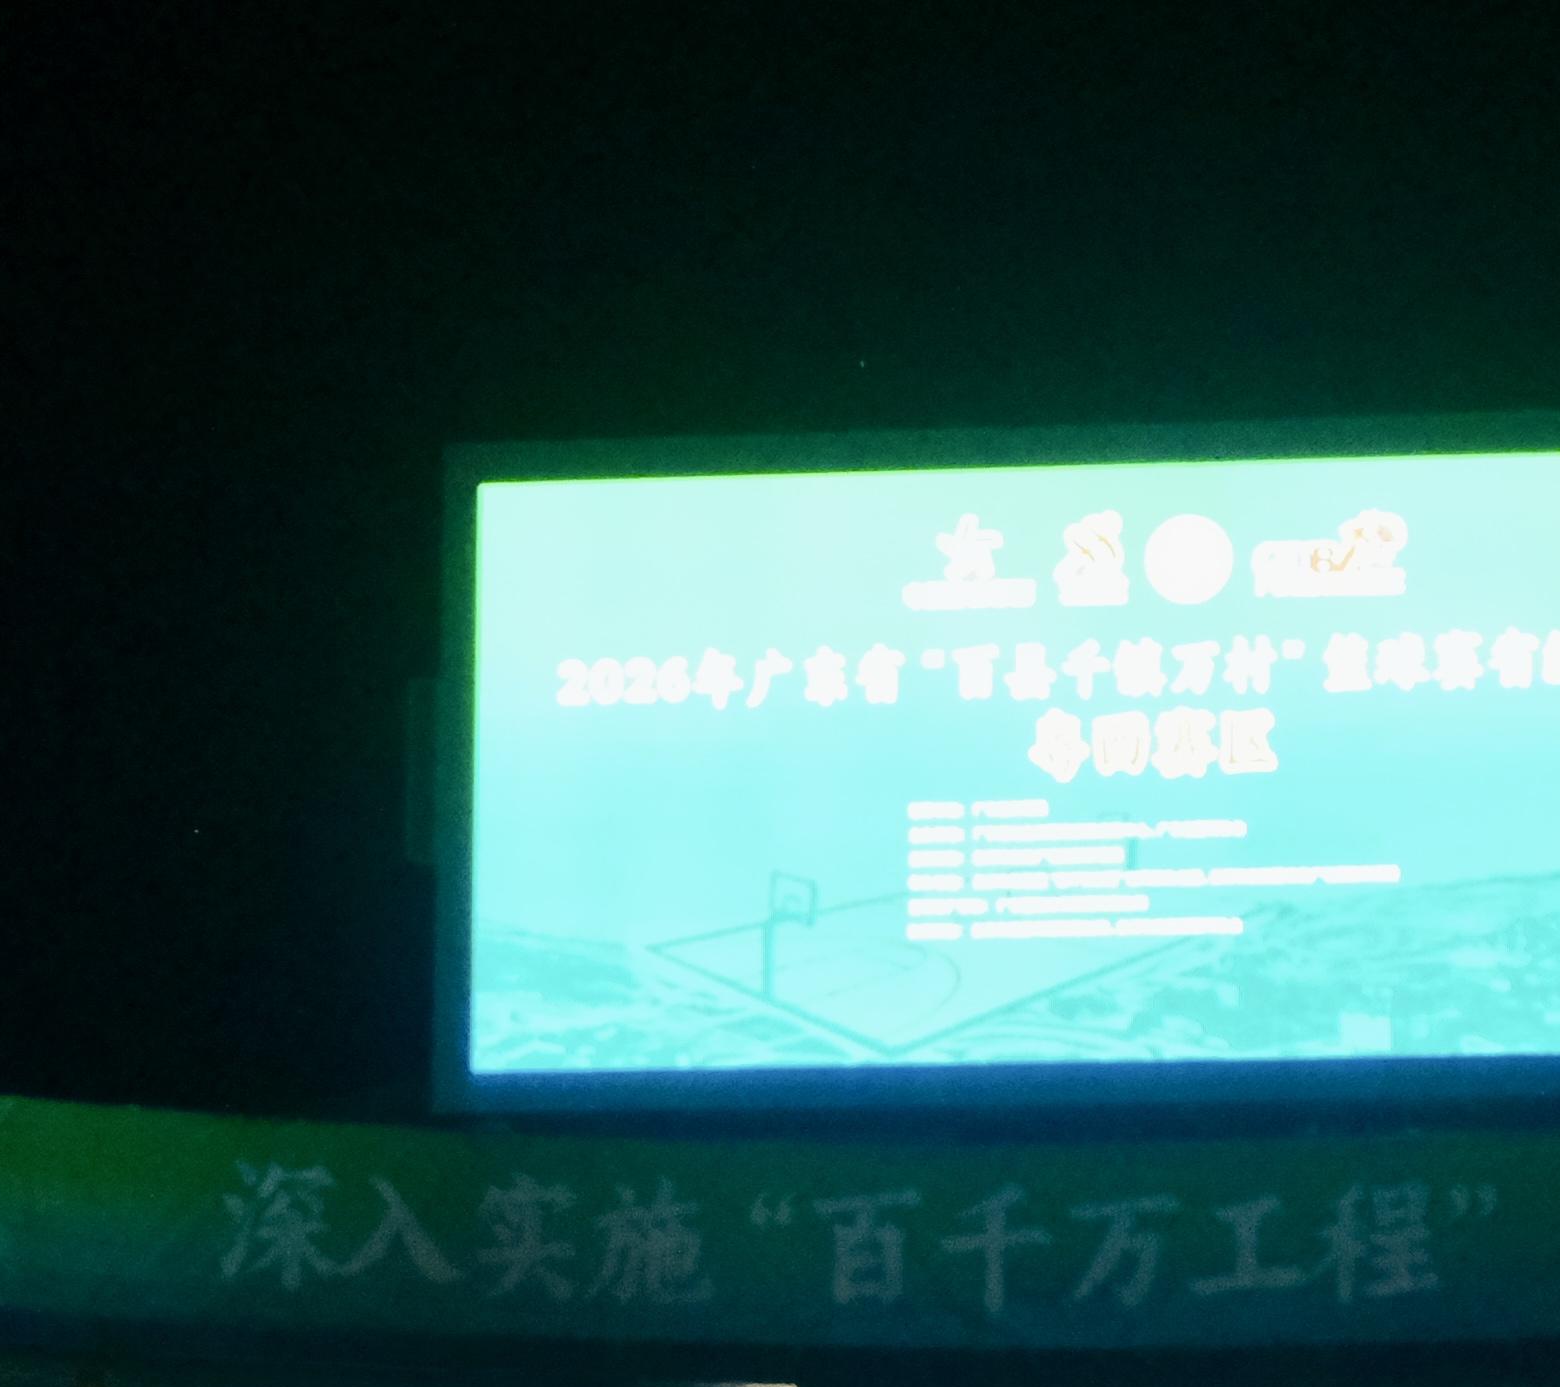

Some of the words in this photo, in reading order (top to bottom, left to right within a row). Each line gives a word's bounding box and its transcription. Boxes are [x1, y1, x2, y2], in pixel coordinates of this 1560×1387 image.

[220, 1160, 1500, 1311] 深入实施“百千万工程”
